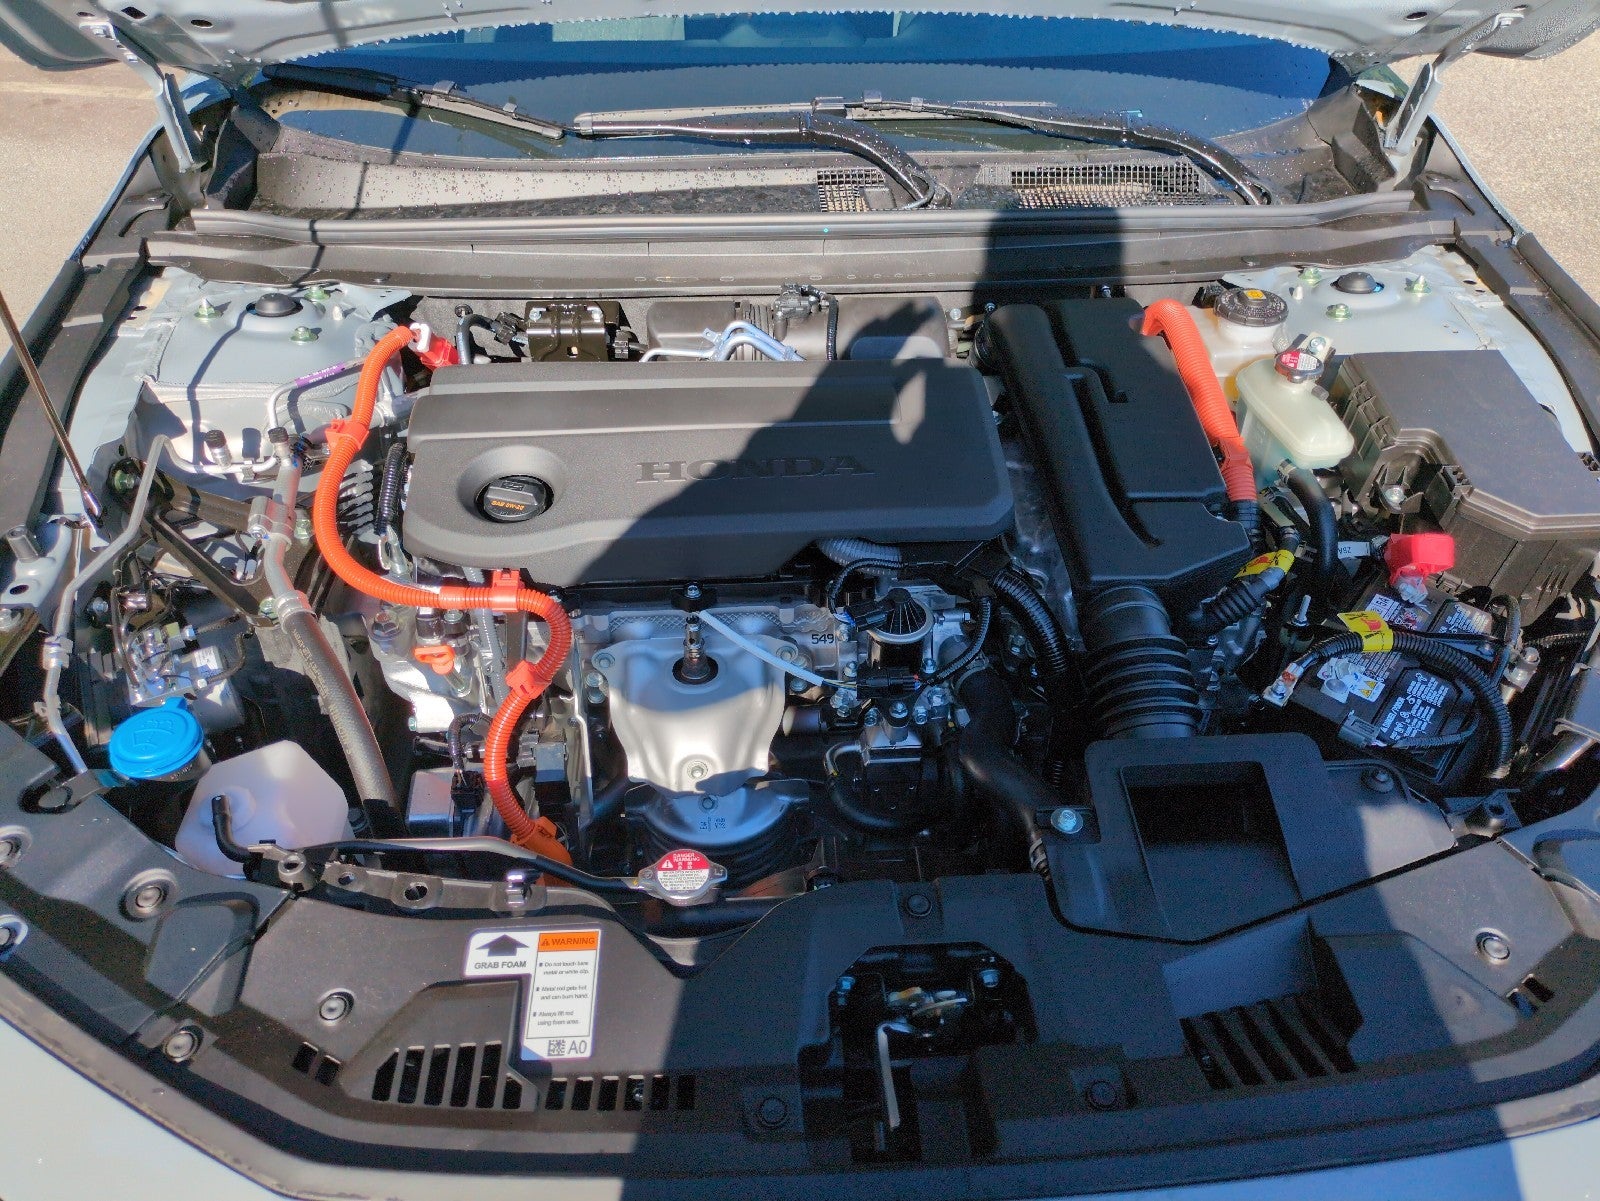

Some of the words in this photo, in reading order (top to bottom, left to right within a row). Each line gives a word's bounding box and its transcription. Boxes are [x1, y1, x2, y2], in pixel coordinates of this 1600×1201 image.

[636, 455, 877, 484] HONDA
[811, 633, 835, 645] 549
[551, 937, 595, 946] WARNING
[474, 961, 500, 970] GRAB
[501, 960, 527, 969] FOAM
[567, 1039, 588, 1055] A0
